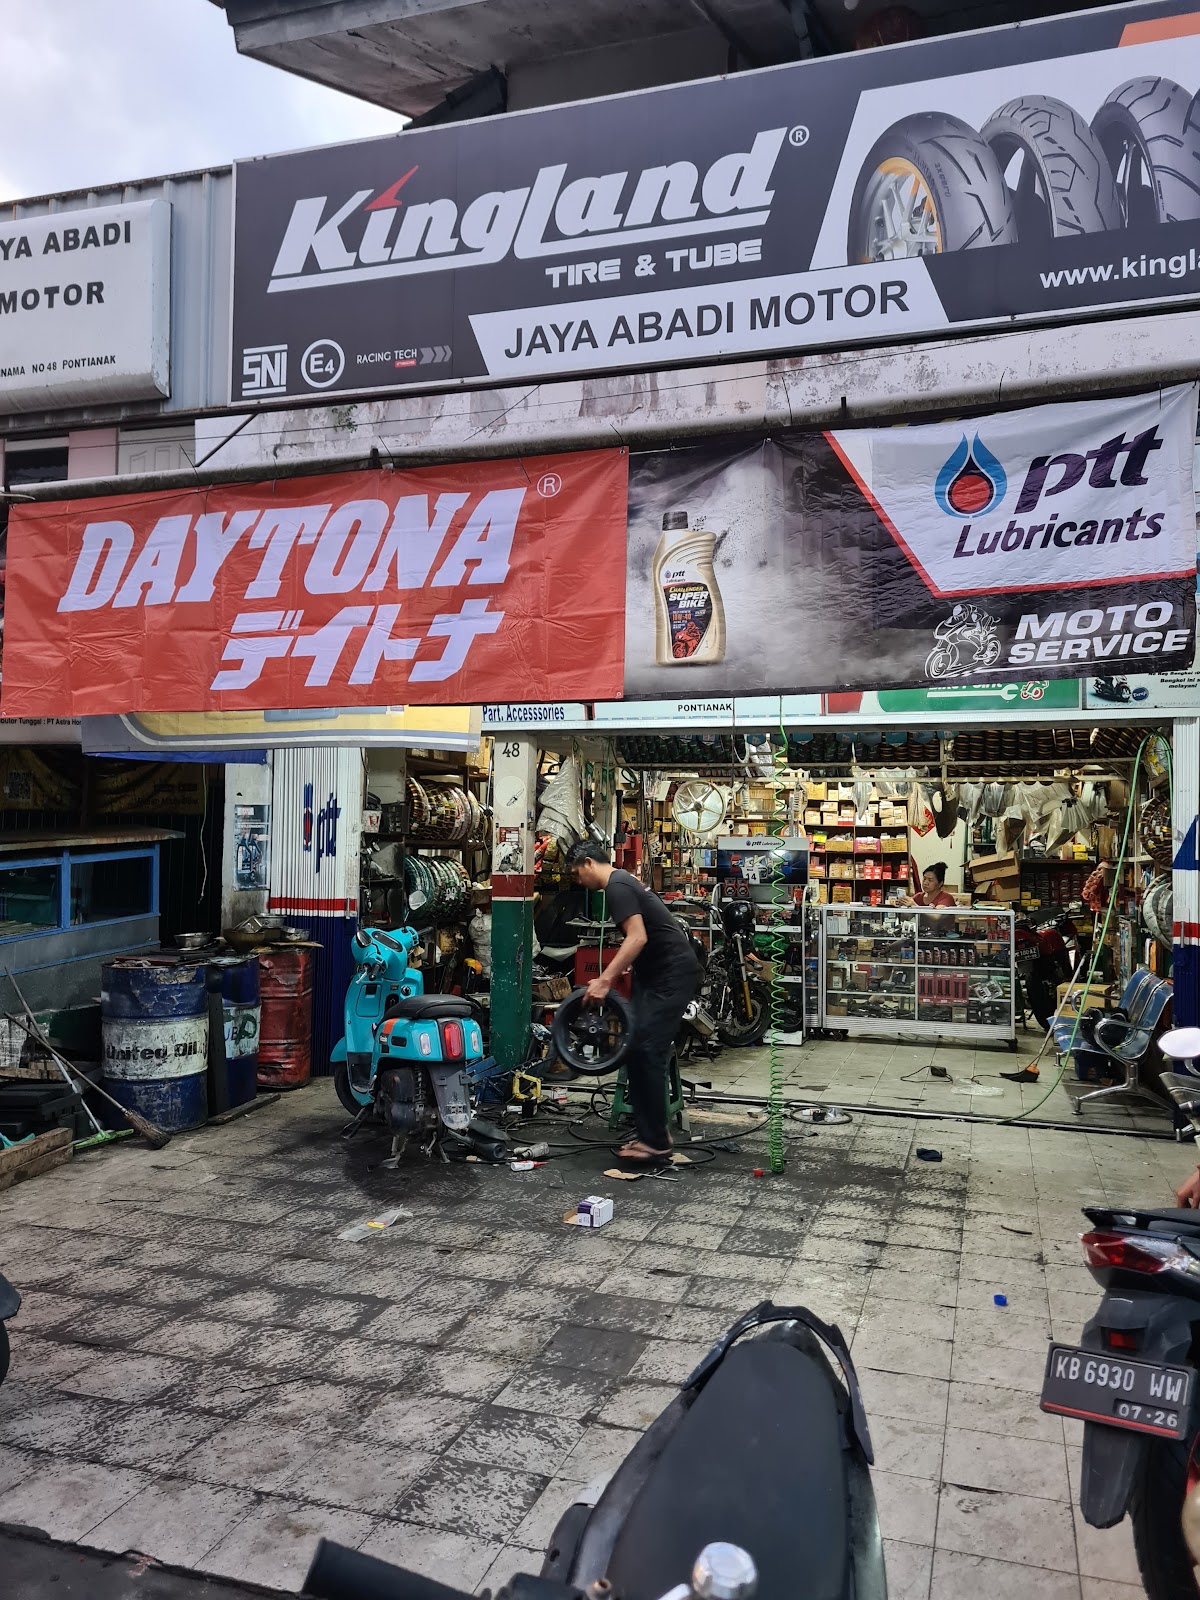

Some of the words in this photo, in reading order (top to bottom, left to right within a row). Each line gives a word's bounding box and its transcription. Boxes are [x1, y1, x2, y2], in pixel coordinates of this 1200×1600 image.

[267, 127, 788, 293] Kingland
[42, 220, 131, 255] ABADI
[545, 258, 621, 288] TIRE
[634, 254, 656, 277] &
[665, 239, 762, 273] TUBE
[1039, 248, 1200, 288] www.kingl
[0, 281, 105, 314] MOTOR
[504, 320, 599, 359] JAYA
[607, 301, 734, 347] ABADI
[749, 280, 910, 331] MOTOR
[62, 355, 117, 369] PONTIANAK
[242, 352, 288, 389] SNI
[310, 353, 335, 374] E4
[356, 351, 392, 364] RACING
[393, 348, 418, 361] TECH
[1013, 424, 1164, 515] ptt
[57, 487, 528, 613] DAYTONA
[952, 507, 1166, 559] Lubricants
[668, 591, 709, 601] SUPER
[678, 600, 705, 608] BIKE
[1014, 601, 1175, 641] MOTO
[209, 598, 506, 691] デイトナ
[1007, 628, 1191, 665] SERVICE
[46, 718, 55, 726] PT
[677, 703, 733, 712] PONTIANAK
[502, 742, 520, 757] 48
[1055, 1356, 1081, 1381] KB
[1084, 1361, 1135, 1393] 6930
[1150, 1373, 1183, 1403] WW
